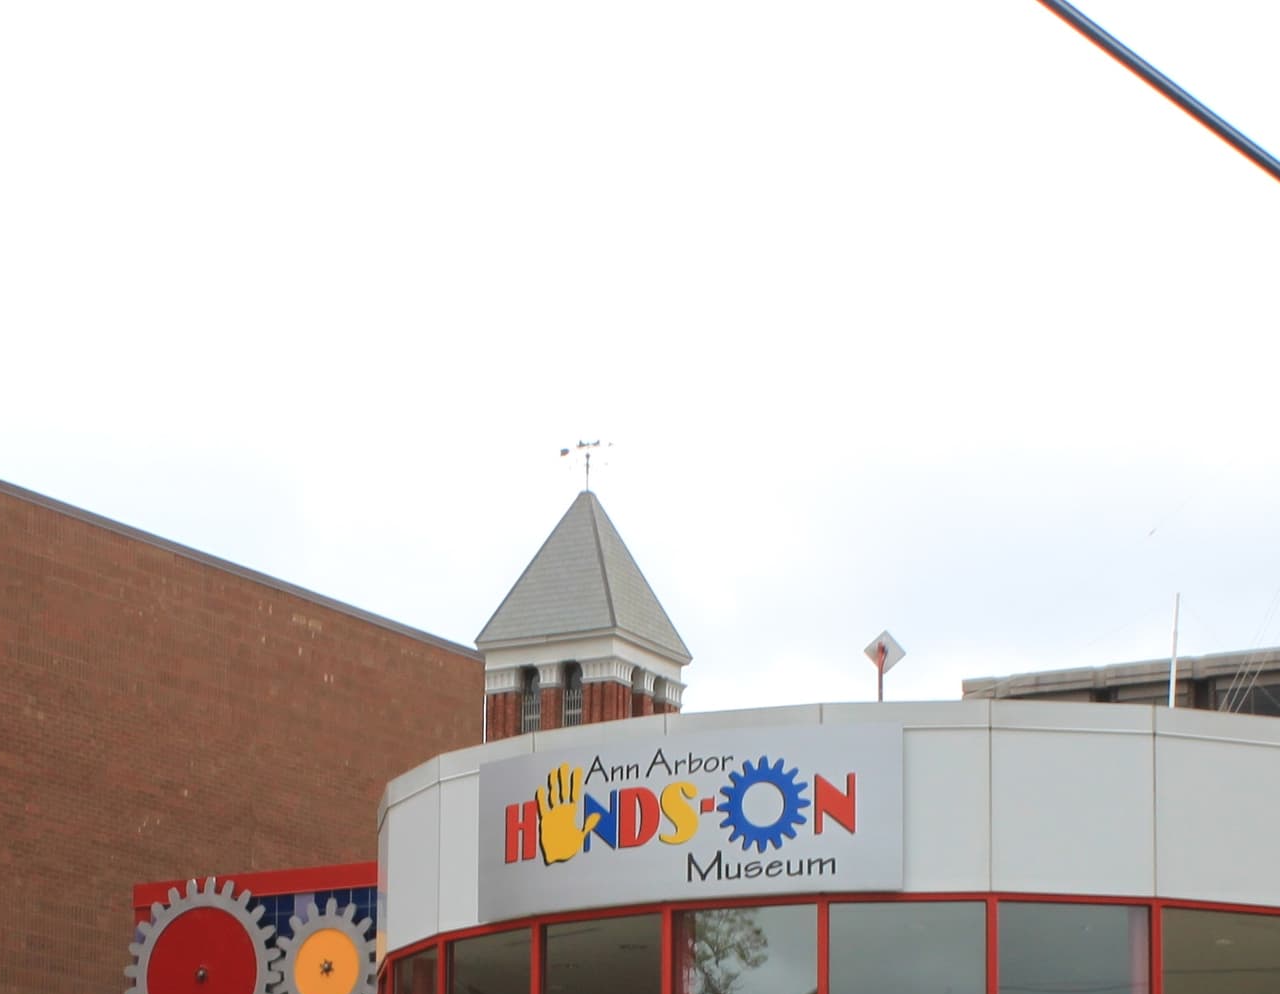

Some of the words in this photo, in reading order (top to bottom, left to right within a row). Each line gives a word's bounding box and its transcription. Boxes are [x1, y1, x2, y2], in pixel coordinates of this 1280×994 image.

[584, 755, 640, 786] Ann
[645, 748, 734, 778] Arbor
[687, 850, 837, 883] Museum
